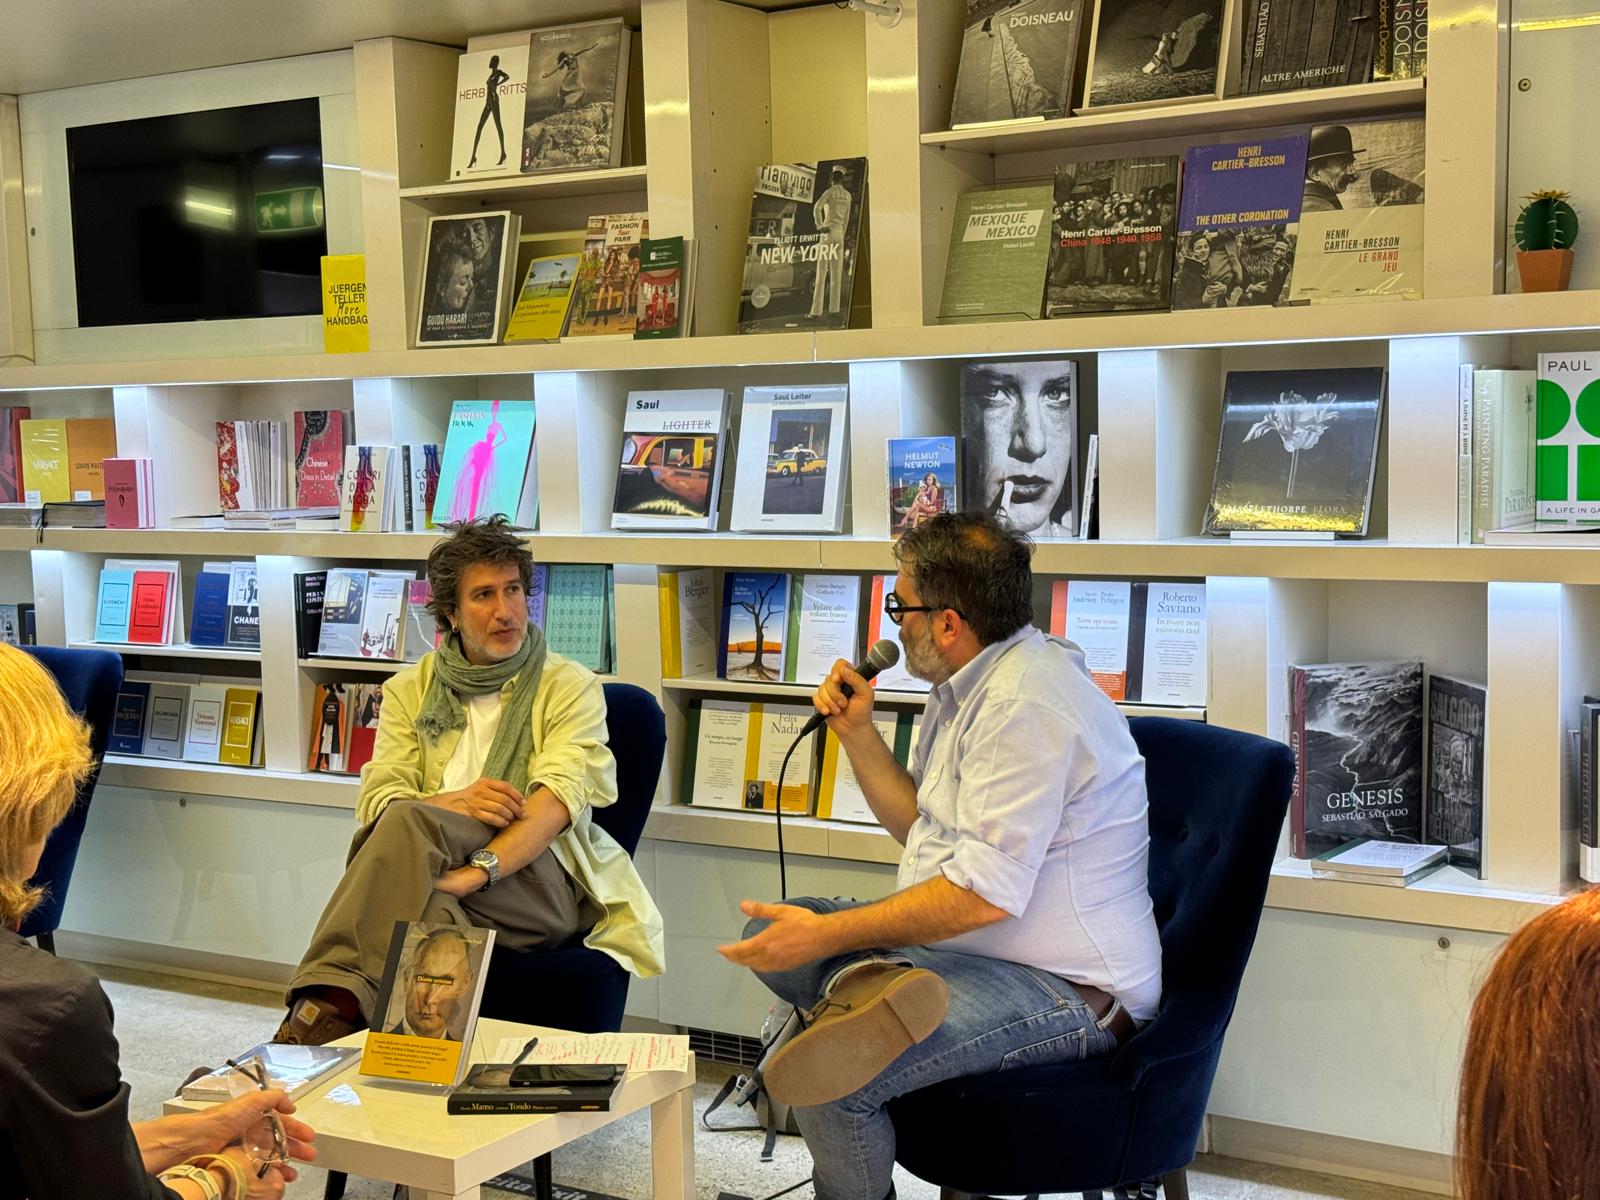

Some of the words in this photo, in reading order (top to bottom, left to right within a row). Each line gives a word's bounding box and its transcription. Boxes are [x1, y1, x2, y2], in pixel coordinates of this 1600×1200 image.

[1010, 10, 1074, 28] DOISNEAU
[1255, 2, 1270, 58] SEBASTIÃO
[1260, 72, 1291, 84] ALTRE
[1293, 64, 1346, 79] AMERICHE
[459, 87, 485, 100] HERB
[500, 82, 528, 96] RITTS
[1238, 146, 1262, 157] HENRI
[1212, 154, 1286, 172] CARTIER-BRESSON
[969, 212, 1028, 227] MEXIQUE
[1196, 215, 1210, 226] THE
[1212, 213, 1237, 225] OTHER
[1238, 210, 1288, 223] CORONATION
[610, 222, 640, 230] FASHION
[986, 224, 1036, 238] MEXICO
[1060, 229, 1085, 238] Henri
[1088, 225, 1162, 236] Cartier-Bresson
[774, 236, 798, 244] ELLIOTT
[1326, 229, 1349, 240] HENRI
[1060, 239, 1088, 248] China
[1324, 237, 1400, 250] CARTIER-BRESSON
[760, 246, 794, 264] NEW
[800, 243, 840, 262] YORK
[1358, 254, 1368, 263] LE
[1372, 251, 1398, 262] GRAND
[1382, 262, 1398, 272] JEU
[328, 283, 366, 294] JUERGEN
[333, 294, 364, 304] TELLER
[427, 314, 445, 326] GUIDO
[446, 312, 466, 325] HARARI
[1548, 360, 1592, 372] PAUL
[774, 392, 790, 400] Saul
[636, 400, 659, 410] Saul
[662, 420, 712, 430] LIGHTER
[1480, 398, 1490, 450] PAINTING
[306, 456, 328, 468] Chinese
[906, 452, 940, 460] HELMUT
[904, 460, 940, 469] NEWTON
[1480, 452, 1490, 508] PARADISE
[685, 586, 708, 598] Berger
[1163, 592, 1198, 602] Roberto
[1158, 601, 1200, 614] Saviano
[234, 616, 258, 624] CHANE
[1431, 690, 1479, 732] SALGADO
[1326, 788, 1404, 808] GENESIS
[1322, 810, 1366, 822] SEBASTIÃO
[1368, 808, 1408, 818] SALGADO
[508, 1102, 532, 1110] Tondo
